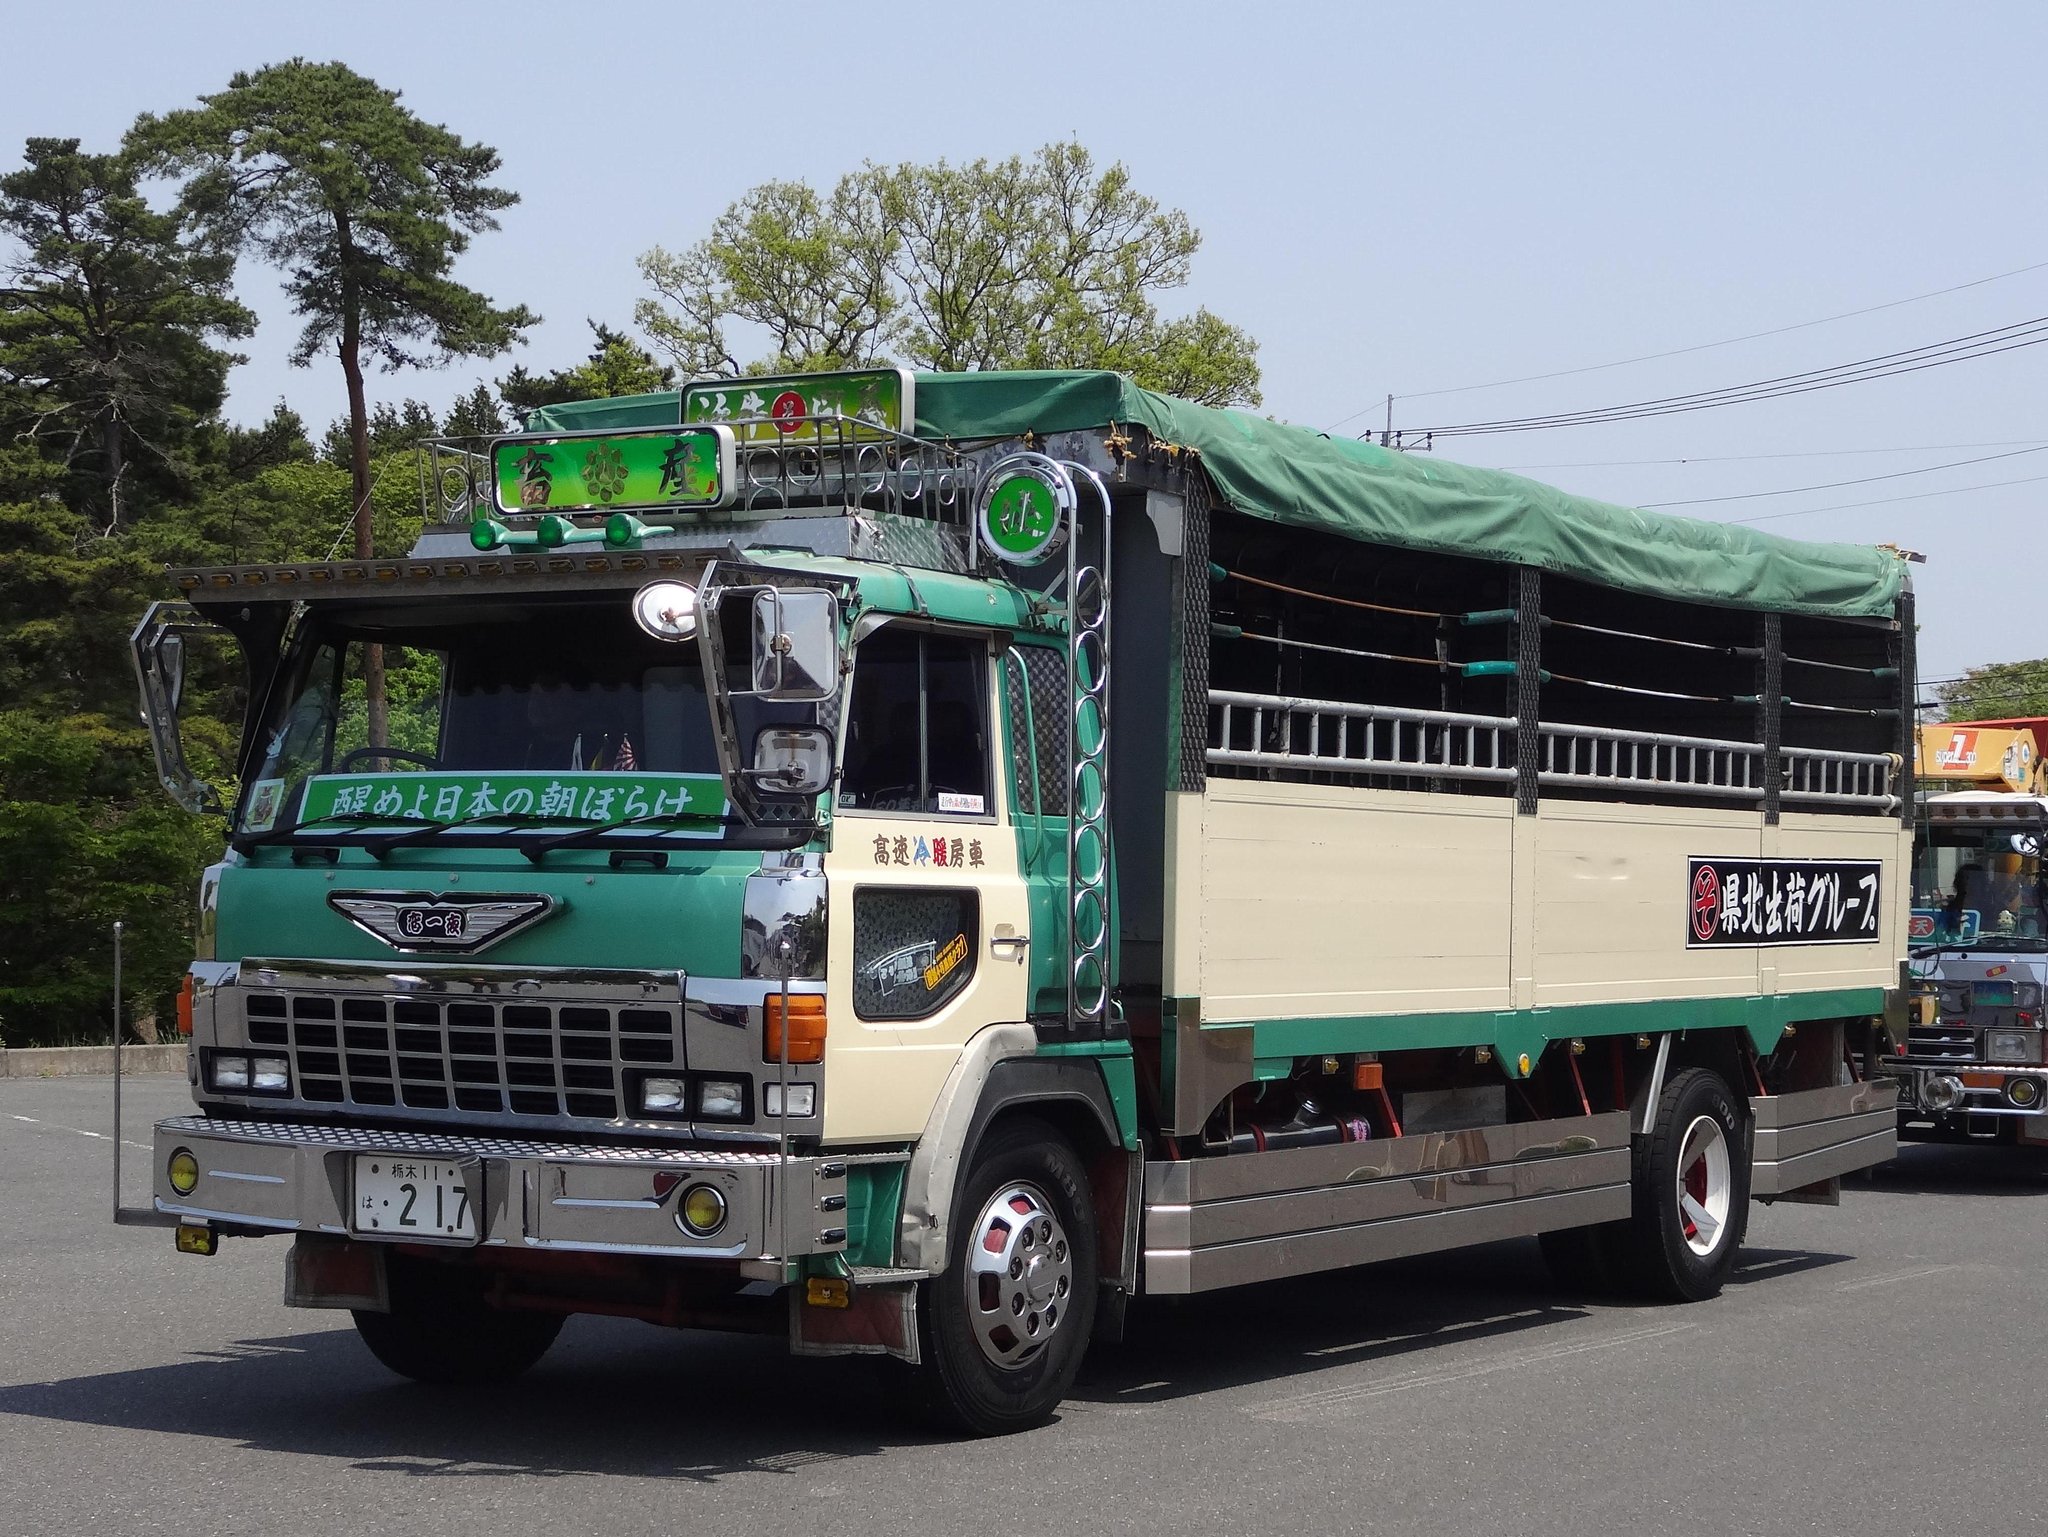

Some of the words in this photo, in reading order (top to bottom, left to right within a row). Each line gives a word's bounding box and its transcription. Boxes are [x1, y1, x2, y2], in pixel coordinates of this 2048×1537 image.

[332, 780, 693, 821] 醒めよ日本の朝ぼらけ
[423, 1165, 438, 1181] 11
[361, 1195, 374, 1209] は
[399, 1183, 469, 1230] 217
